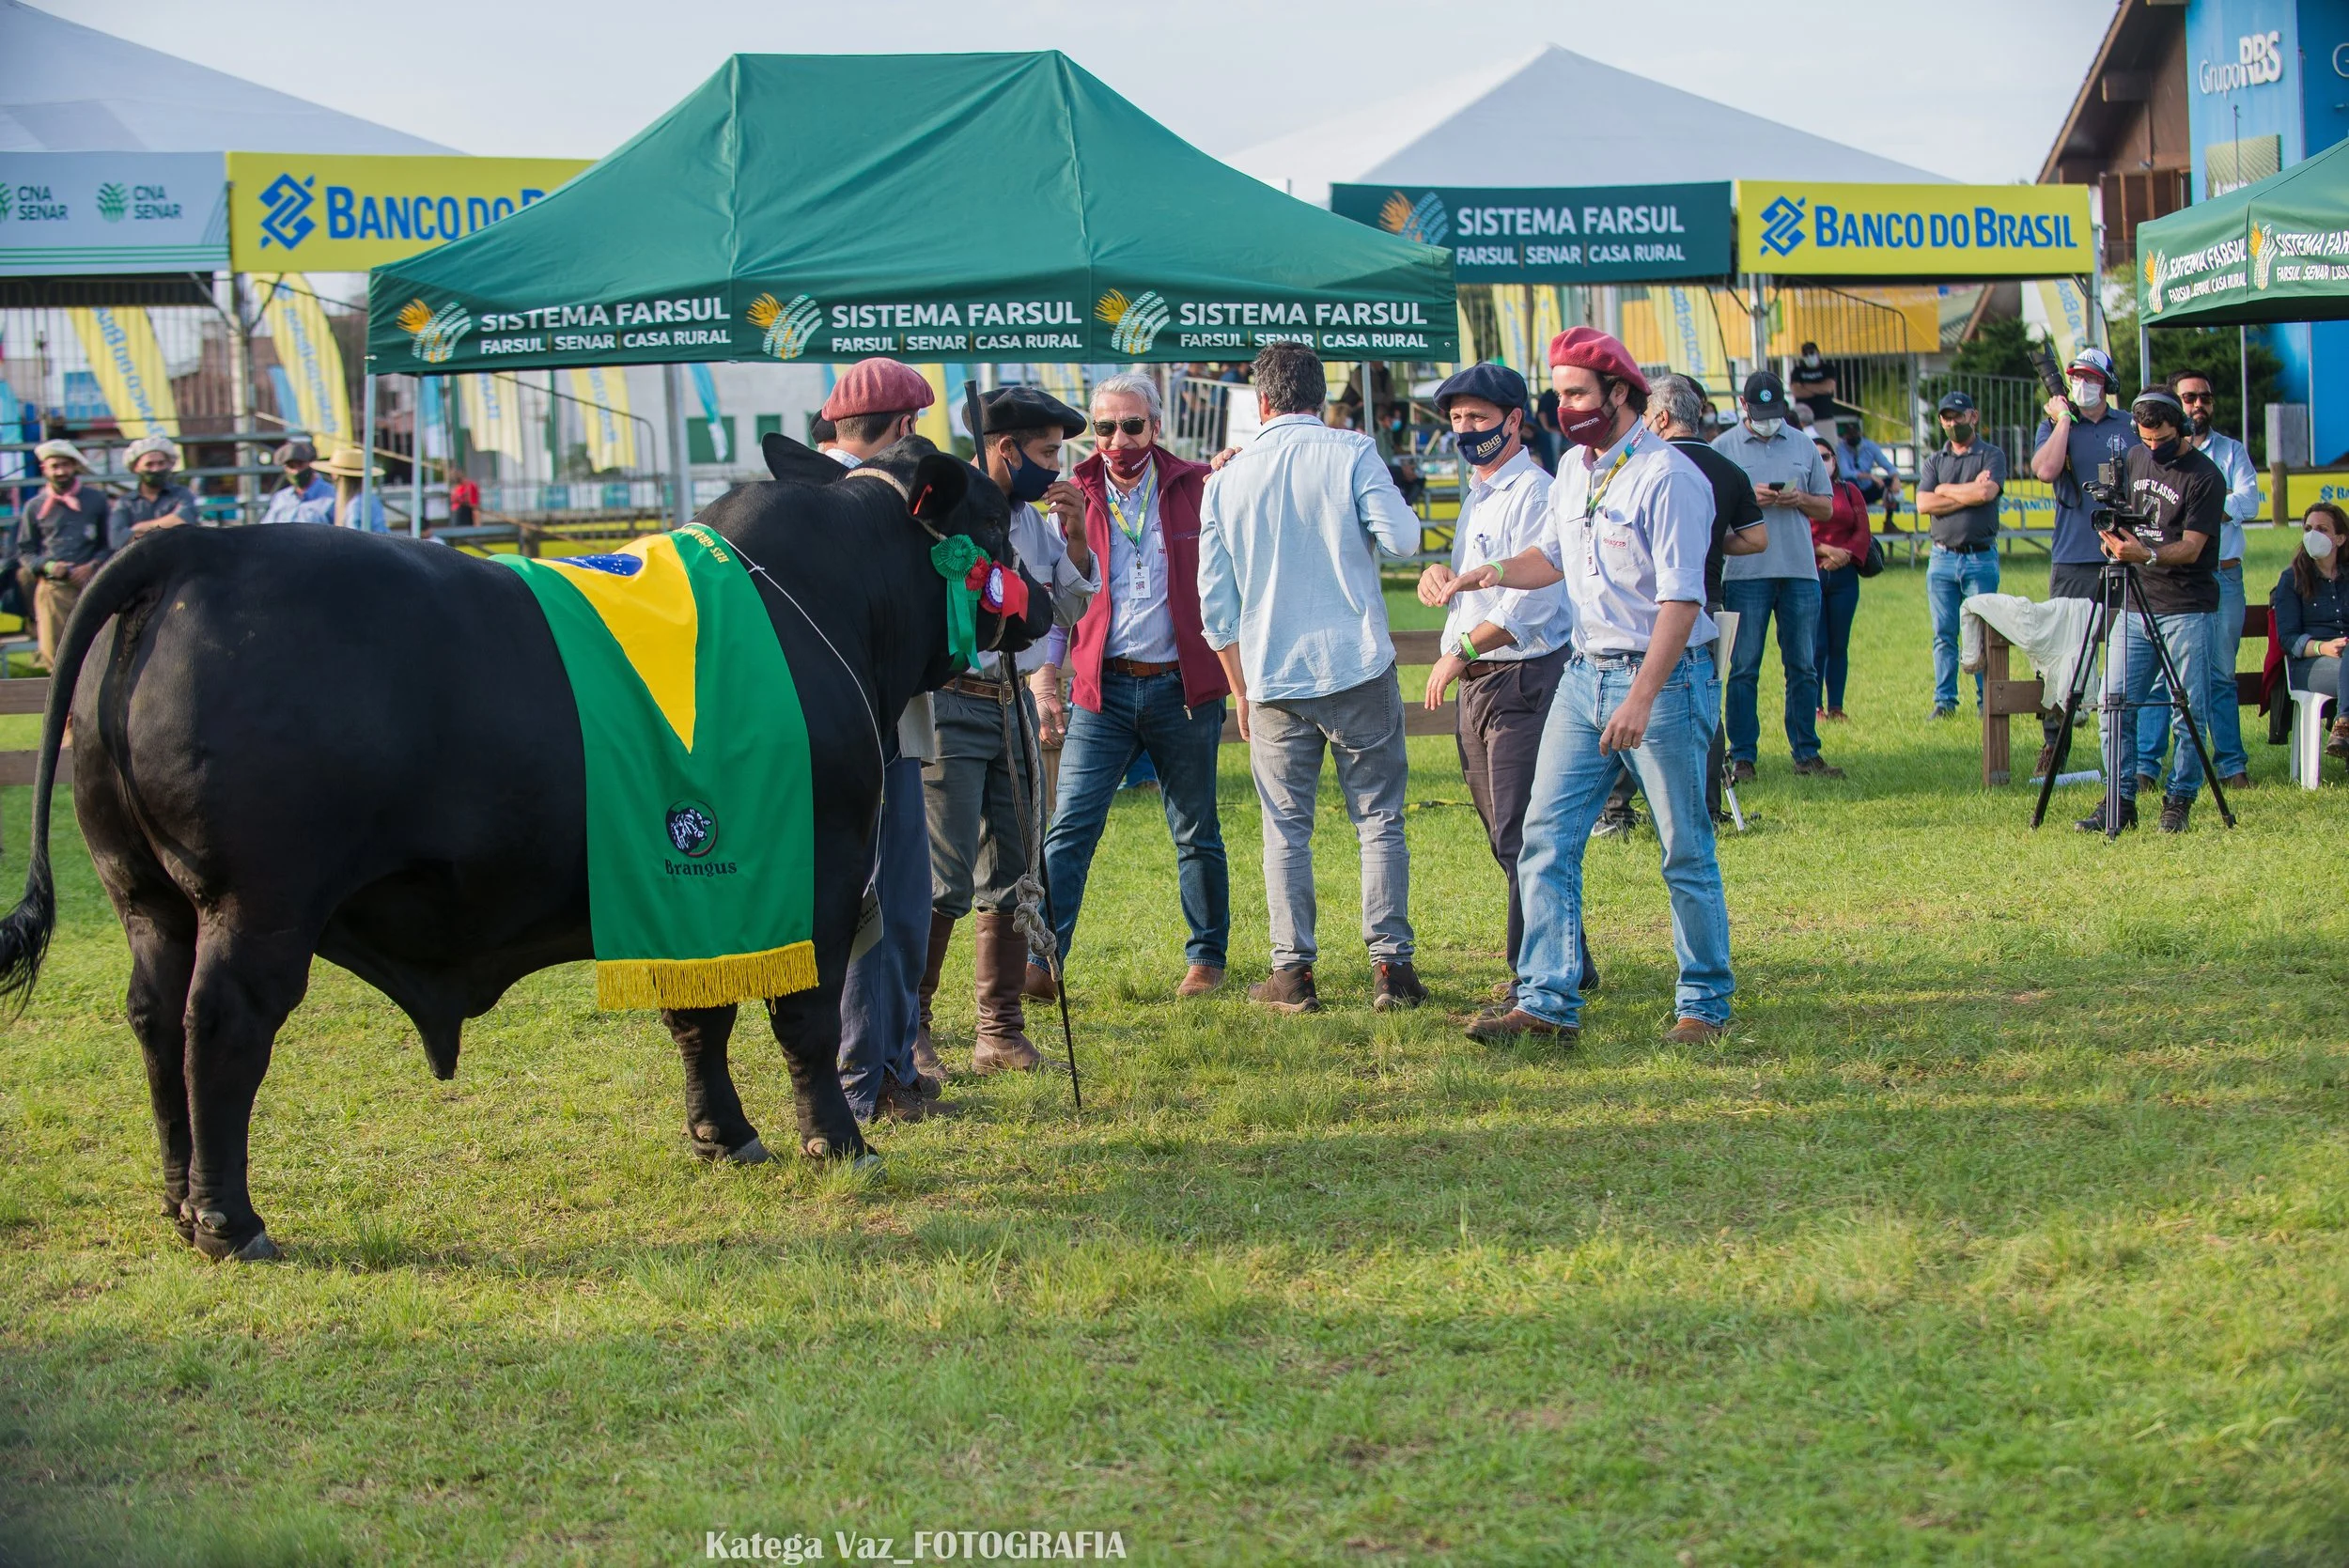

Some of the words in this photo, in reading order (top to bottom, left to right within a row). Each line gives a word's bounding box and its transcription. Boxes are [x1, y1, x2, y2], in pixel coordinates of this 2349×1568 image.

[18, 186, 53, 202] CNA
[133, 186, 167, 201] CNA
[19, 205, 68, 221] SENAR
[134, 204, 182, 219] SENAR
[326, 186, 461, 241] BANCO
[1457, 207, 1577, 236] SISTEMA
[1583, 205, 1685, 234] FARSUL
[1815, 205, 1924, 248] BANCO
[1930, 214, 1970, 248] DO
[1975, 207, 2077, 248] BRASIL
[2276, 233, 2325, 256] SISTEMA
[2323, 230, 2349, 256] FAR
[1456, 246, 1518, 266] FARSUL
[1525, 244, 1582, 264] SENAR
[1588, 244, 1631, 263] CASA
[1634, 244, 1686, 262] RURAL
[2168, 250, 2209, 280] SISTEMA
[2207, 238, 2247, 270] FARSUL
[2277, 266, 2299, 282] FARSUL
[2303, 264, 2329, 280] SENAR
[2169, 285, 2190, 303] FARSUL
[2212, 276, 2227, 293] CASA
[2227, 272, 2247, 288] RURAL
[480, 303, 610, 333] SISTEMA
[616, 298, 731, 325] FARSUL
[832, 302, 961, 328] SISTEMA
[968, 302, 1082, 325] FARSUL
[1180, 303, 1308, 326] SISTEMA
[1315, 302, 1427, 325] FARSUL
[480, 337, 547, 355] FARSUL
[554, 334, 615, 350] SENAR
[623, 331, 672, 348] CASA
[674, 329, 731, 346] RURAL
[832, 336, 898, 354] FARSUL
[906, 334, 968, 351] SENAR
[974, 334, 1023, 350] CASA
[1024, 334, 1083, 349] RURAL
[1180, 333, 1246, 348] FARSUL
[1254, 333, 1315, 349] SENAR
[1322, 334, 1371, 349] CASA
[1372, 334, 1429, 349] RURAL
[1476, 434, 1501, 455] ABHB
[664, 859, 737, 877] Brangus
